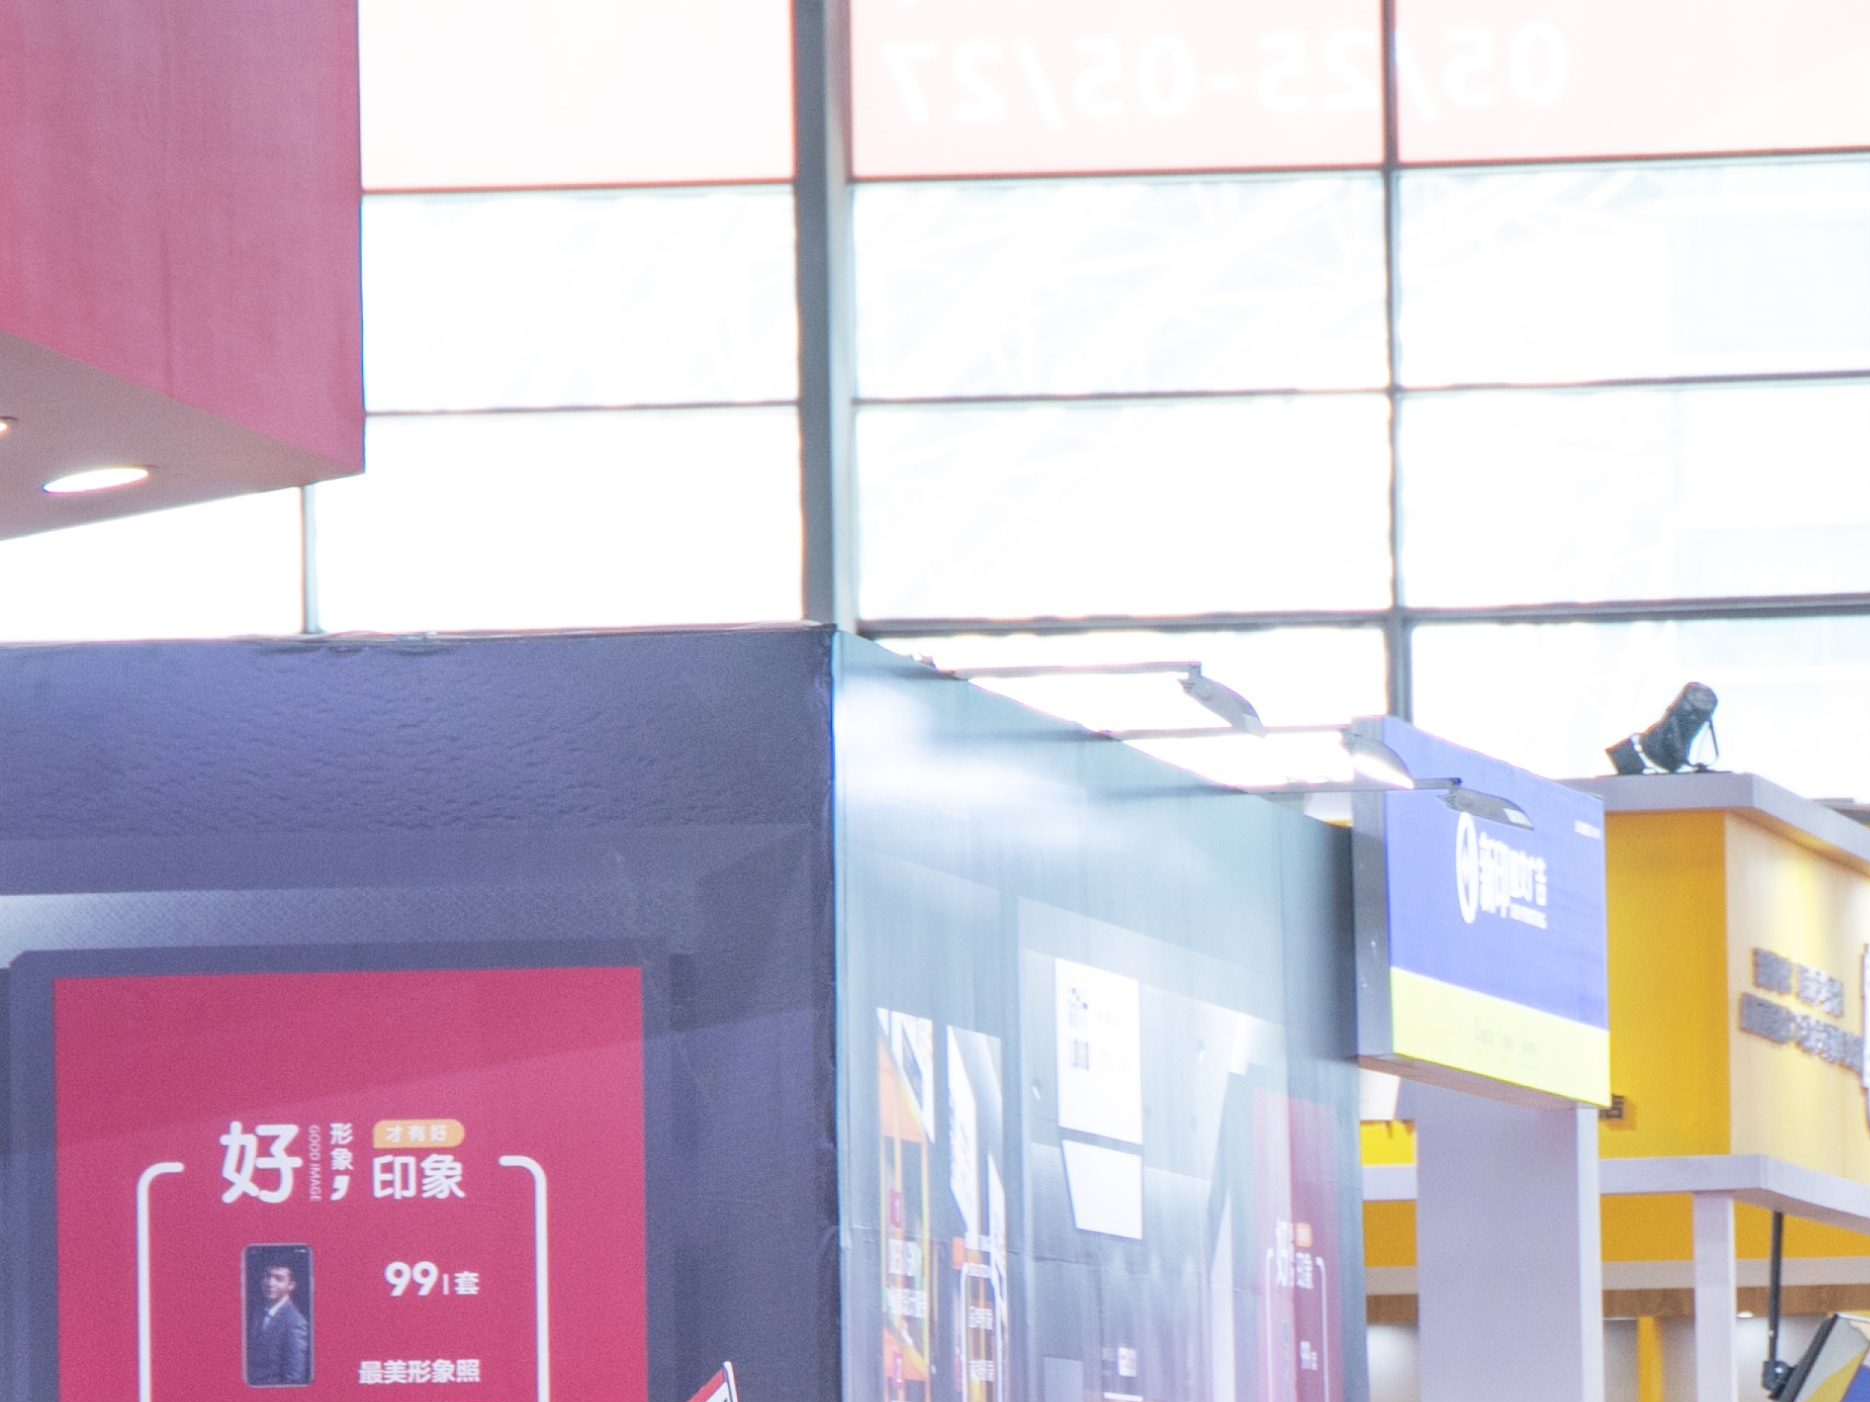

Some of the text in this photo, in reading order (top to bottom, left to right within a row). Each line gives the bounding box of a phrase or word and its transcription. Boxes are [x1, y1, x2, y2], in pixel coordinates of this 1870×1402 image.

[385, 1123, 448, 1144] 才有好
[219, 1121, 303, 1204] 好
[308, 1124, 321, 1202] GOOD IMAGE
[373, 1154, 466, 1200] 印象
[358, 1358, 481, 1385] 最美形象照
